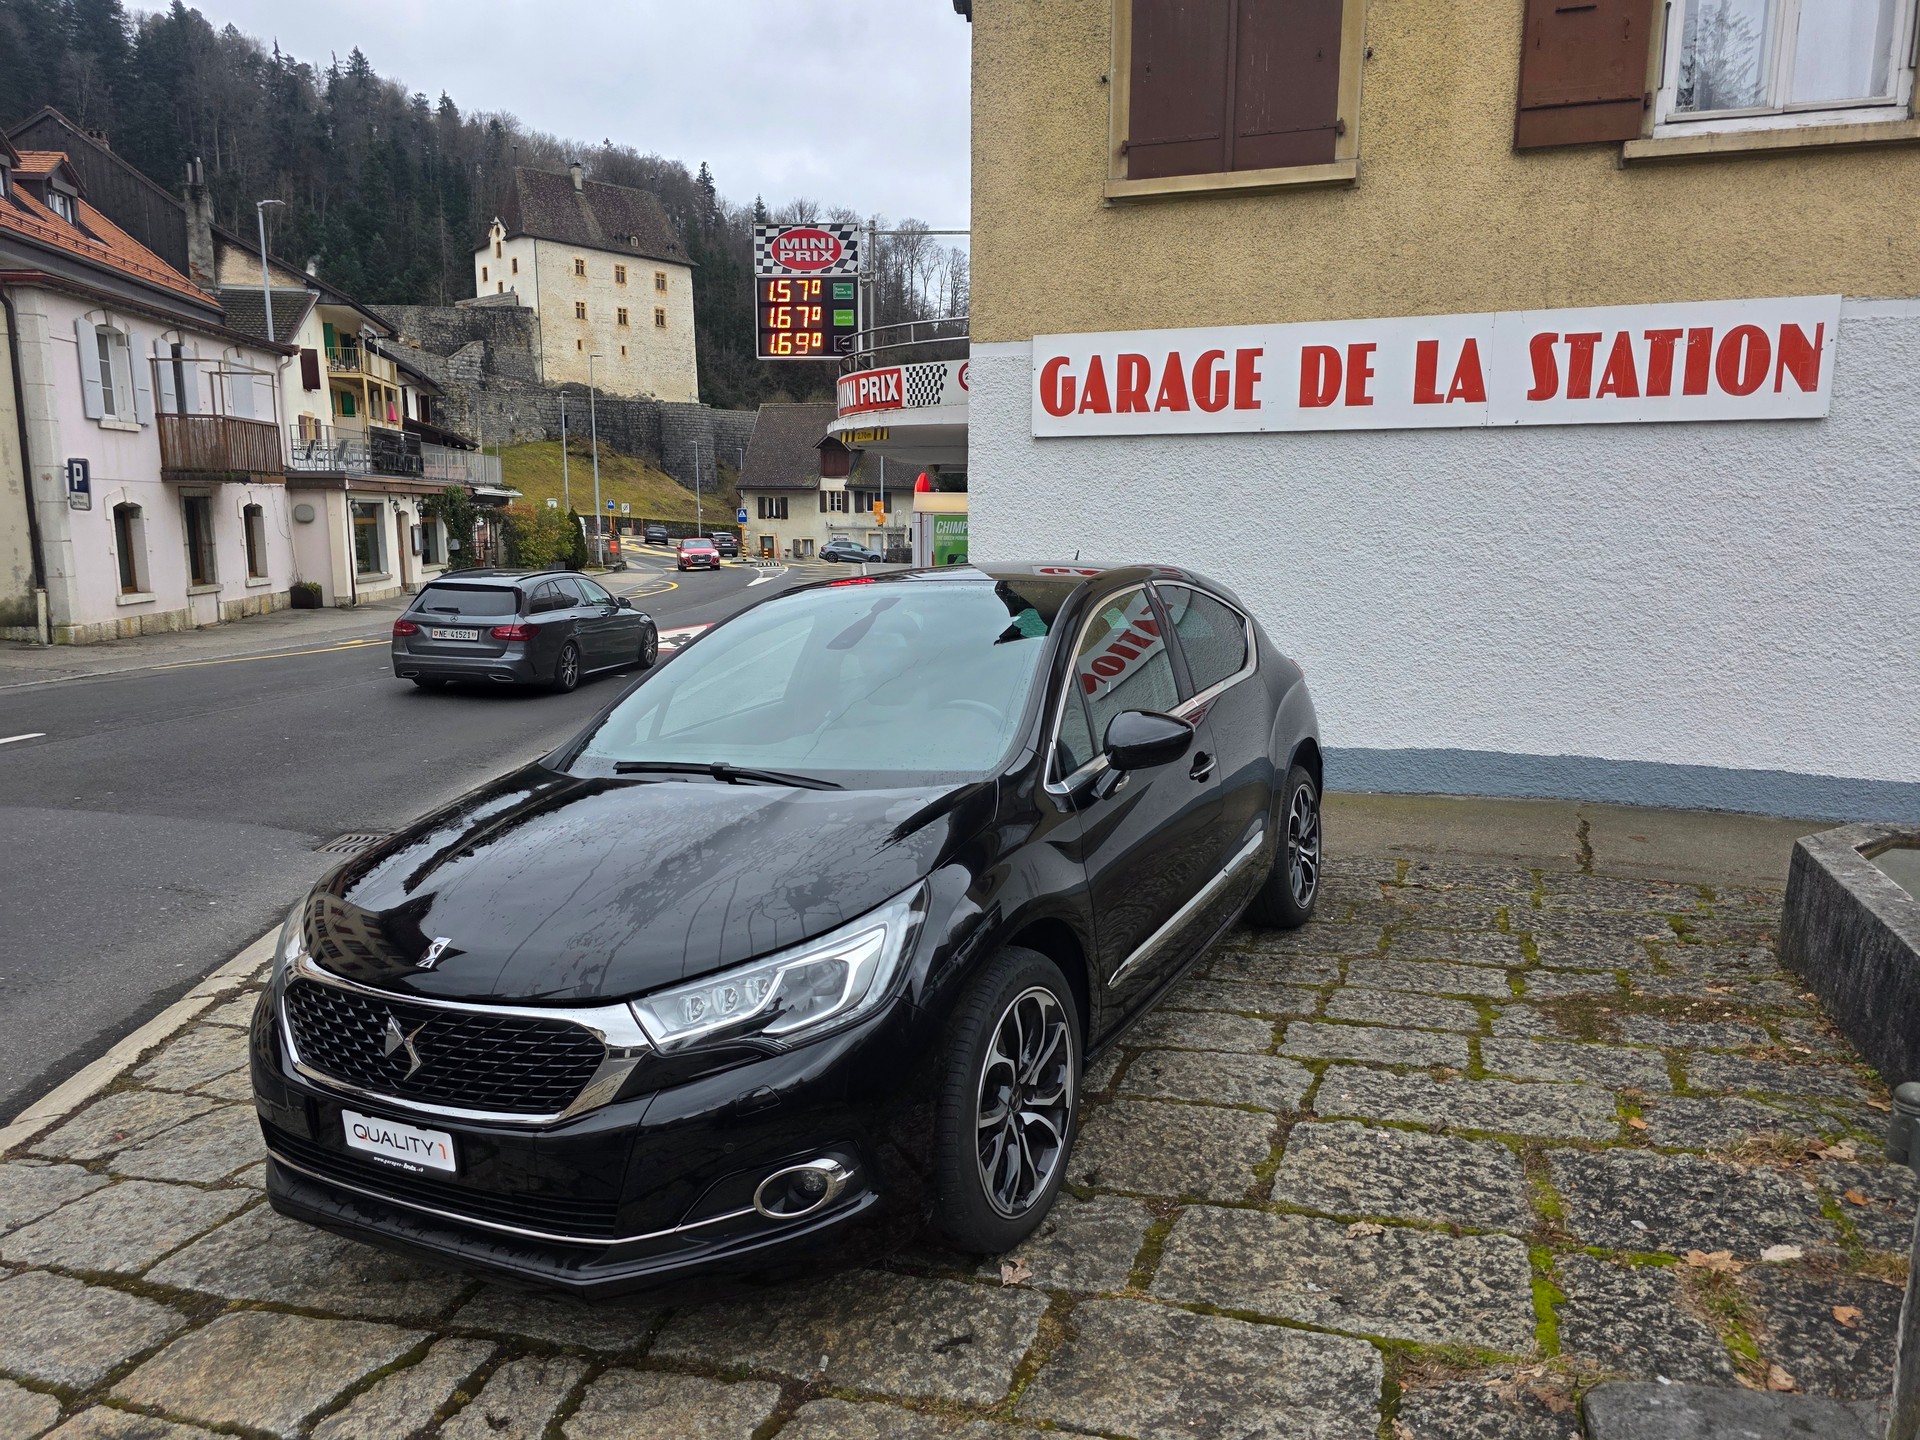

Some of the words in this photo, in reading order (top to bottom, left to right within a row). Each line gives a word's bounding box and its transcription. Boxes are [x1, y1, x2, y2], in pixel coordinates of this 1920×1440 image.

[779, 237, 834, 250] MINI
[779, 250, 835, 262] PRIX
[1039, 347, 1264, 418] GARAGE
[1299, 342, 1377, 409] DE
[1413, 337, 1488, 405] LA
[1527, 322, 1825, 402] STATION
[859, 373, 900, 405] PRIX
[72, 463, 84, 490] P
[438, 630, 448, 638] NE
[450, 630, 471, 639] 41521
[353, 1123, 434, 1156] QUALITY
[438, 1142, 447, 1160] 1
